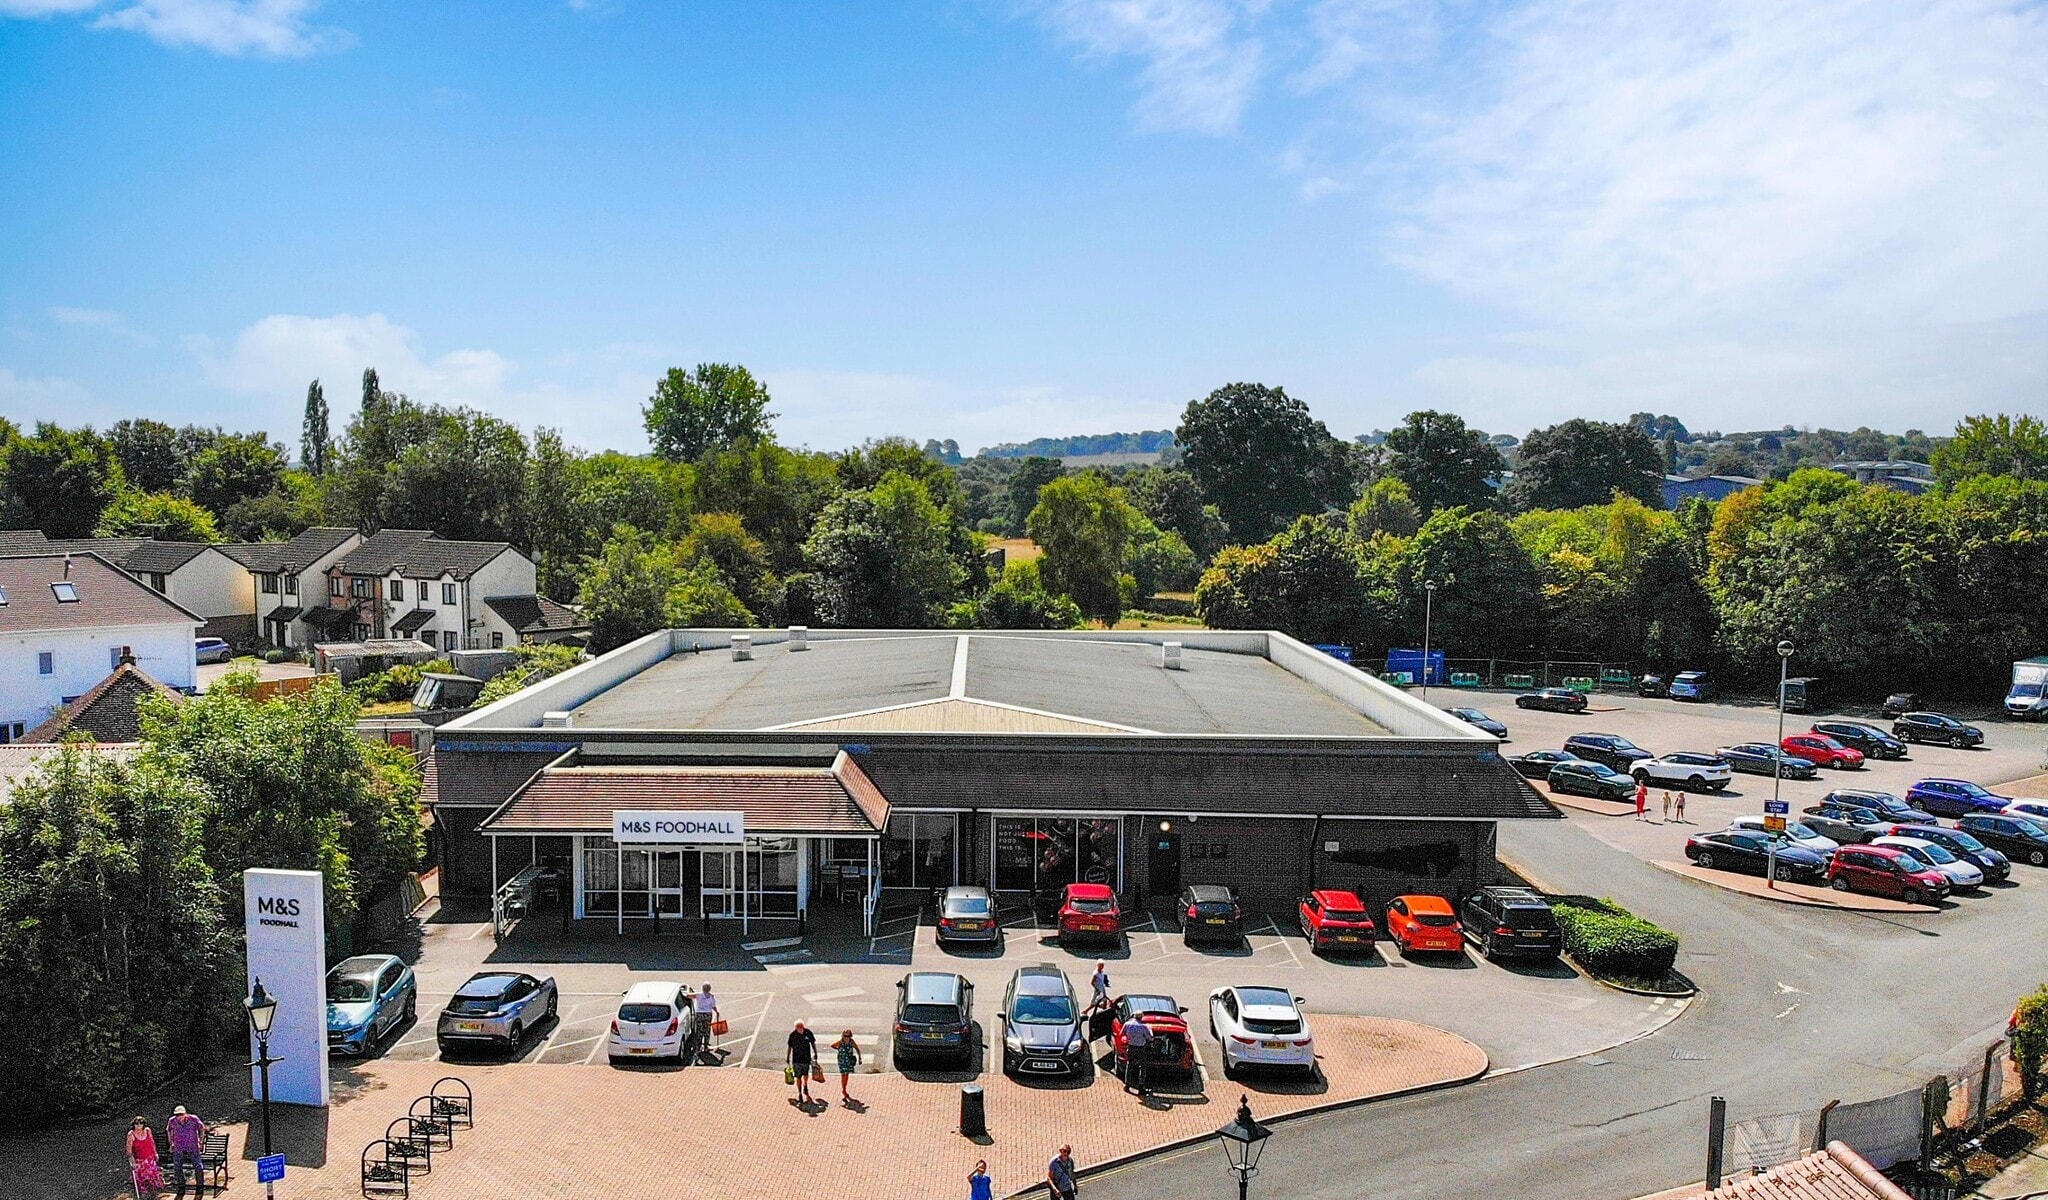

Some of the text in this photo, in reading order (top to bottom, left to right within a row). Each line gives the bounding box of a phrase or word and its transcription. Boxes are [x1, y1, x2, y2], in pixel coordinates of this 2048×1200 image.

[621, 821, 734, 834] M&S FOODHALL
[258, 896, 300, 916] M&S
[260, 919, 299, 928] FOODHALL
[260, 1164, 283, 1174] SHORT
[263, 1171, 280, 1180] STAY
